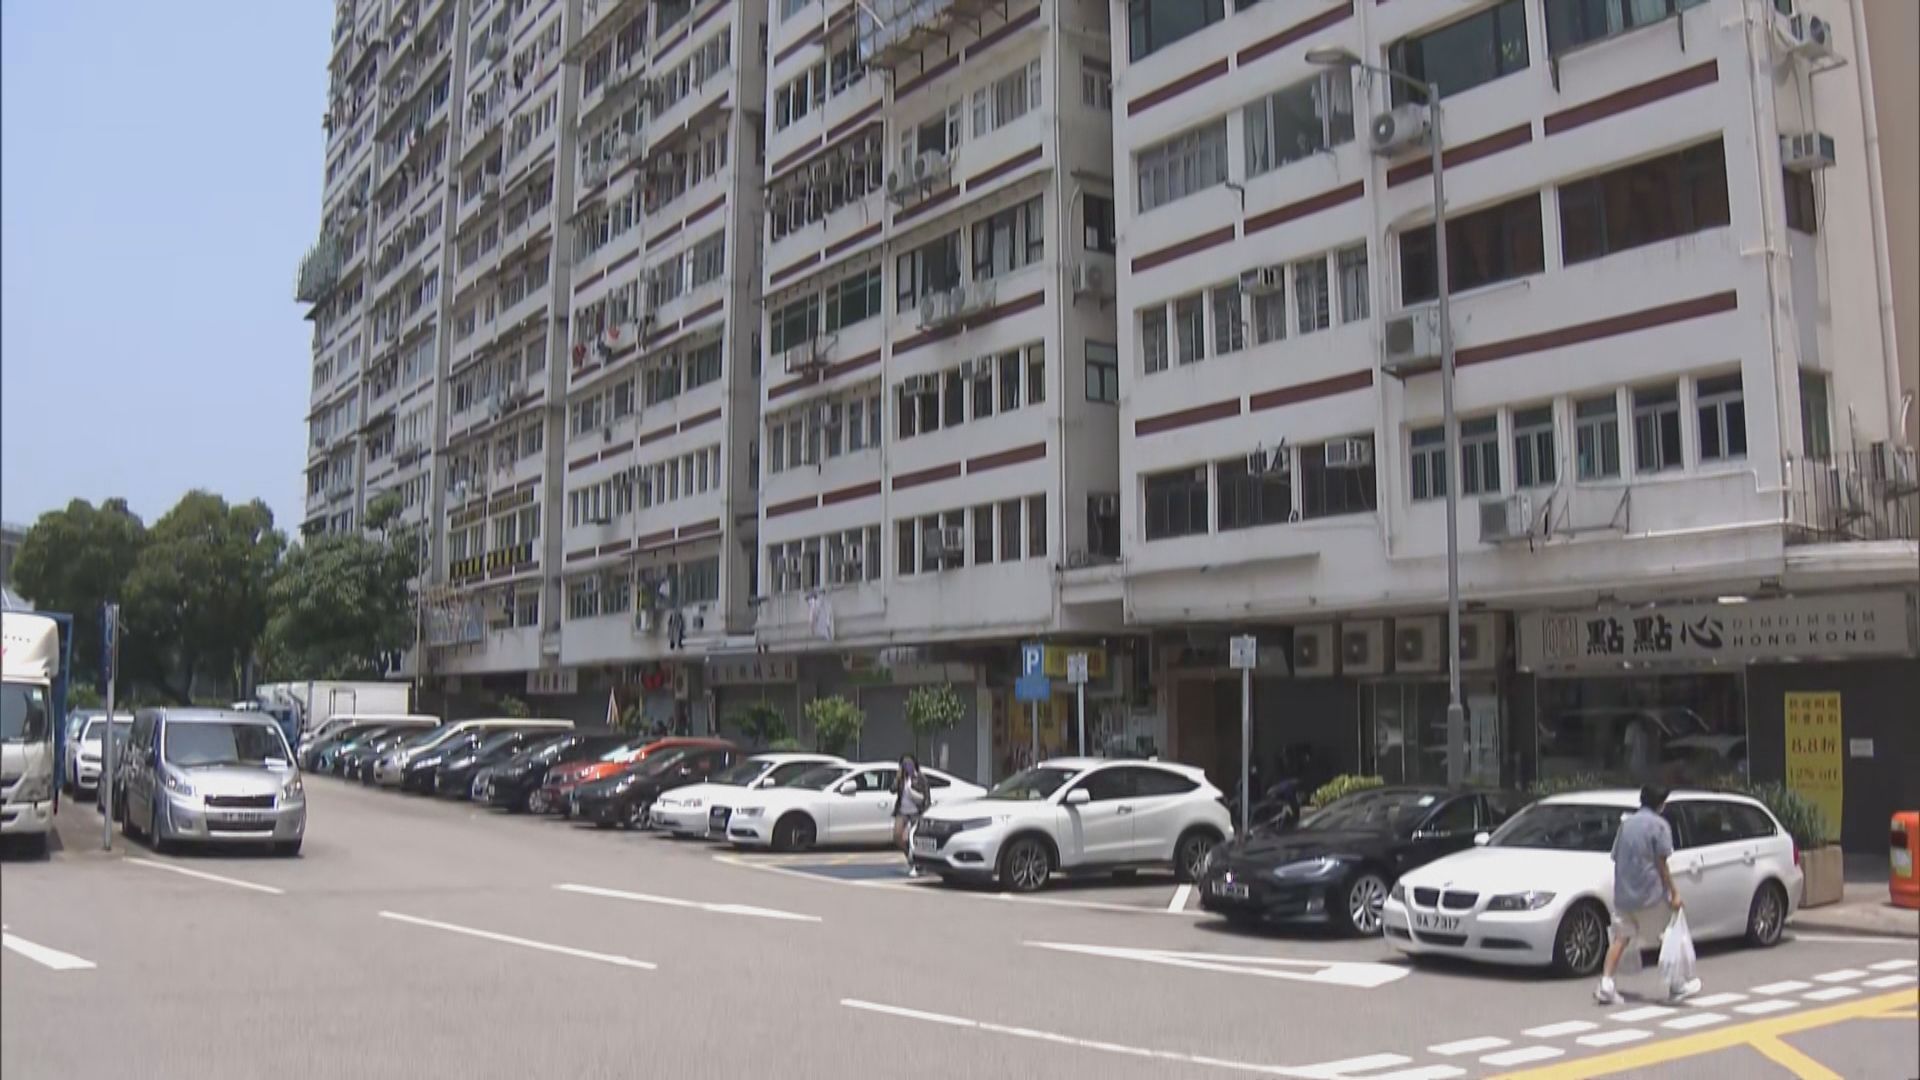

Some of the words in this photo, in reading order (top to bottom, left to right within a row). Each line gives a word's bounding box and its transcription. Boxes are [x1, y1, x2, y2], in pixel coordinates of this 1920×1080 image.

[1586, 614, 1724, 655] 點點心
[1733, 633, 1797, 648] HONG
[1808, 629, 1876, 644] KONG
[1026, 647, 1039, 675] P
